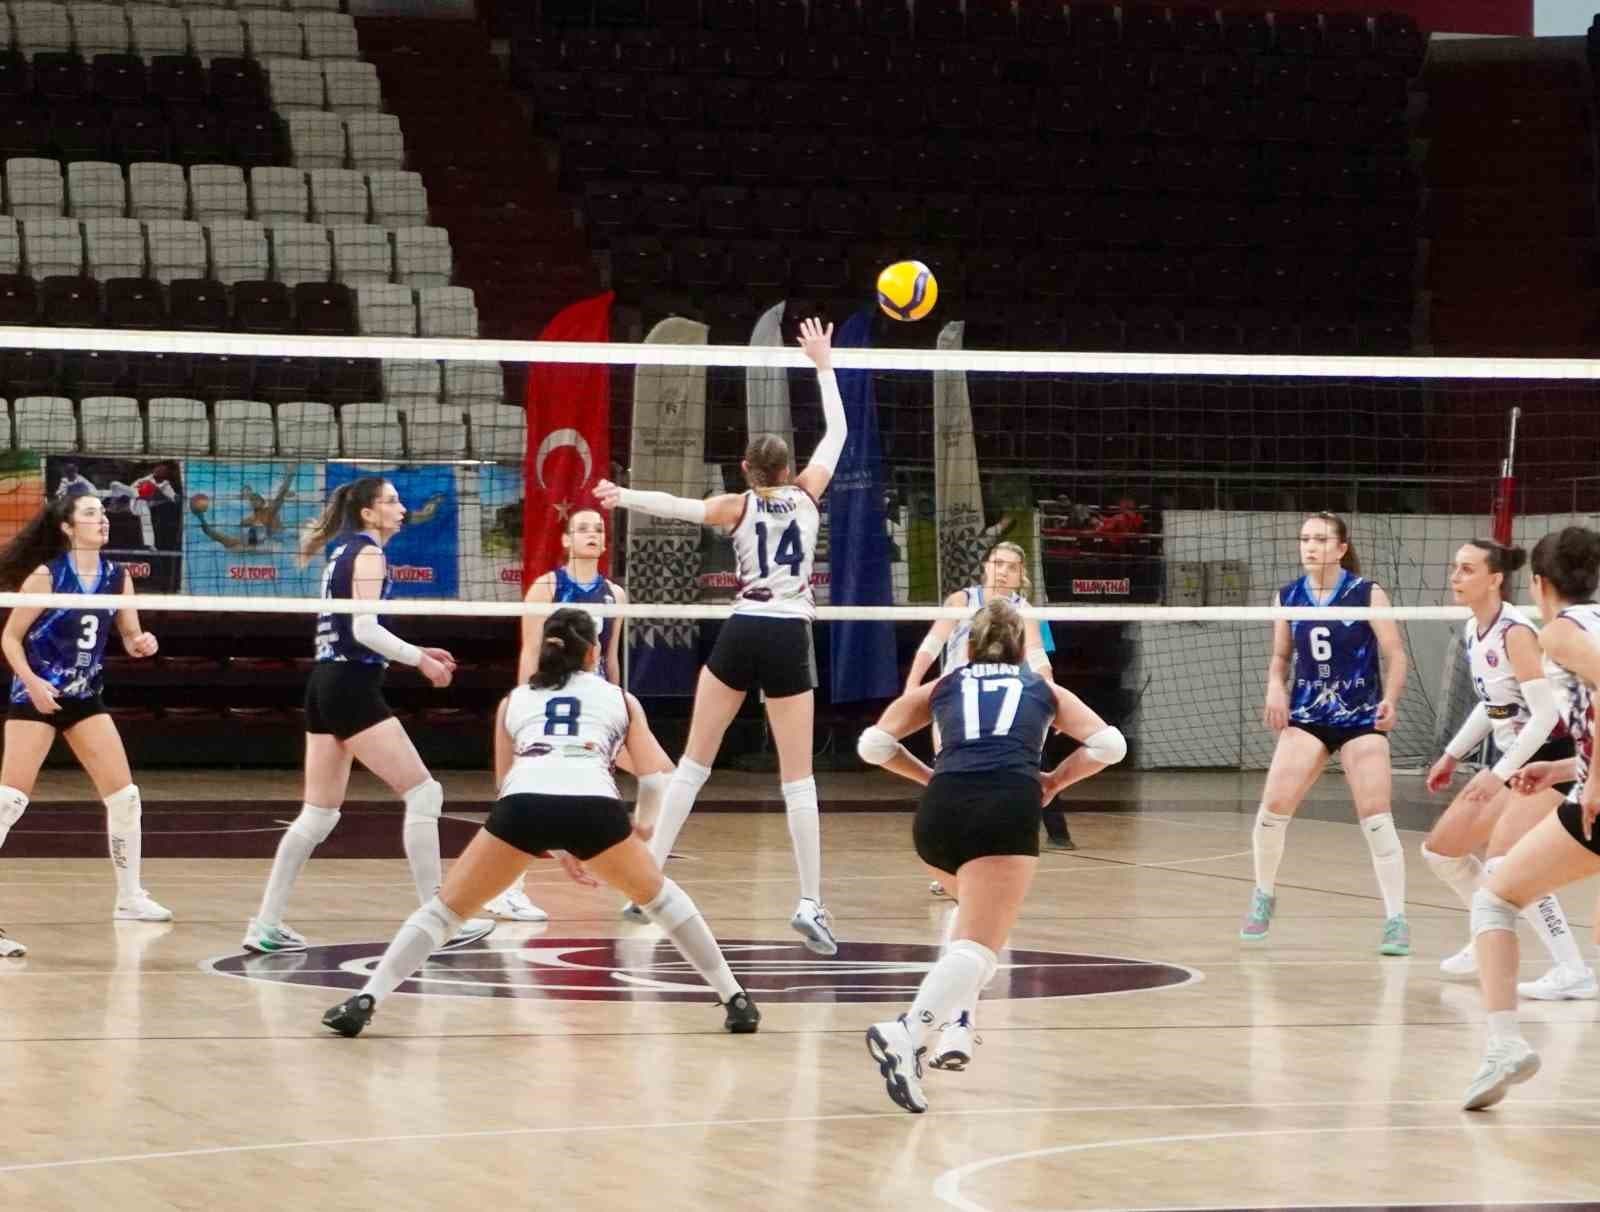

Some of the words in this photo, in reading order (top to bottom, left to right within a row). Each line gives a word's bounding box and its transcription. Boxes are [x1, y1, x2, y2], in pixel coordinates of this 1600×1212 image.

[755, 520, 804, 578] 14
[77, 615, 98, 649] 3
[1310, 626, 1332, 661] 6
[543, 696, 580, 736] 8
[961, 677, 1024, 740] 17
